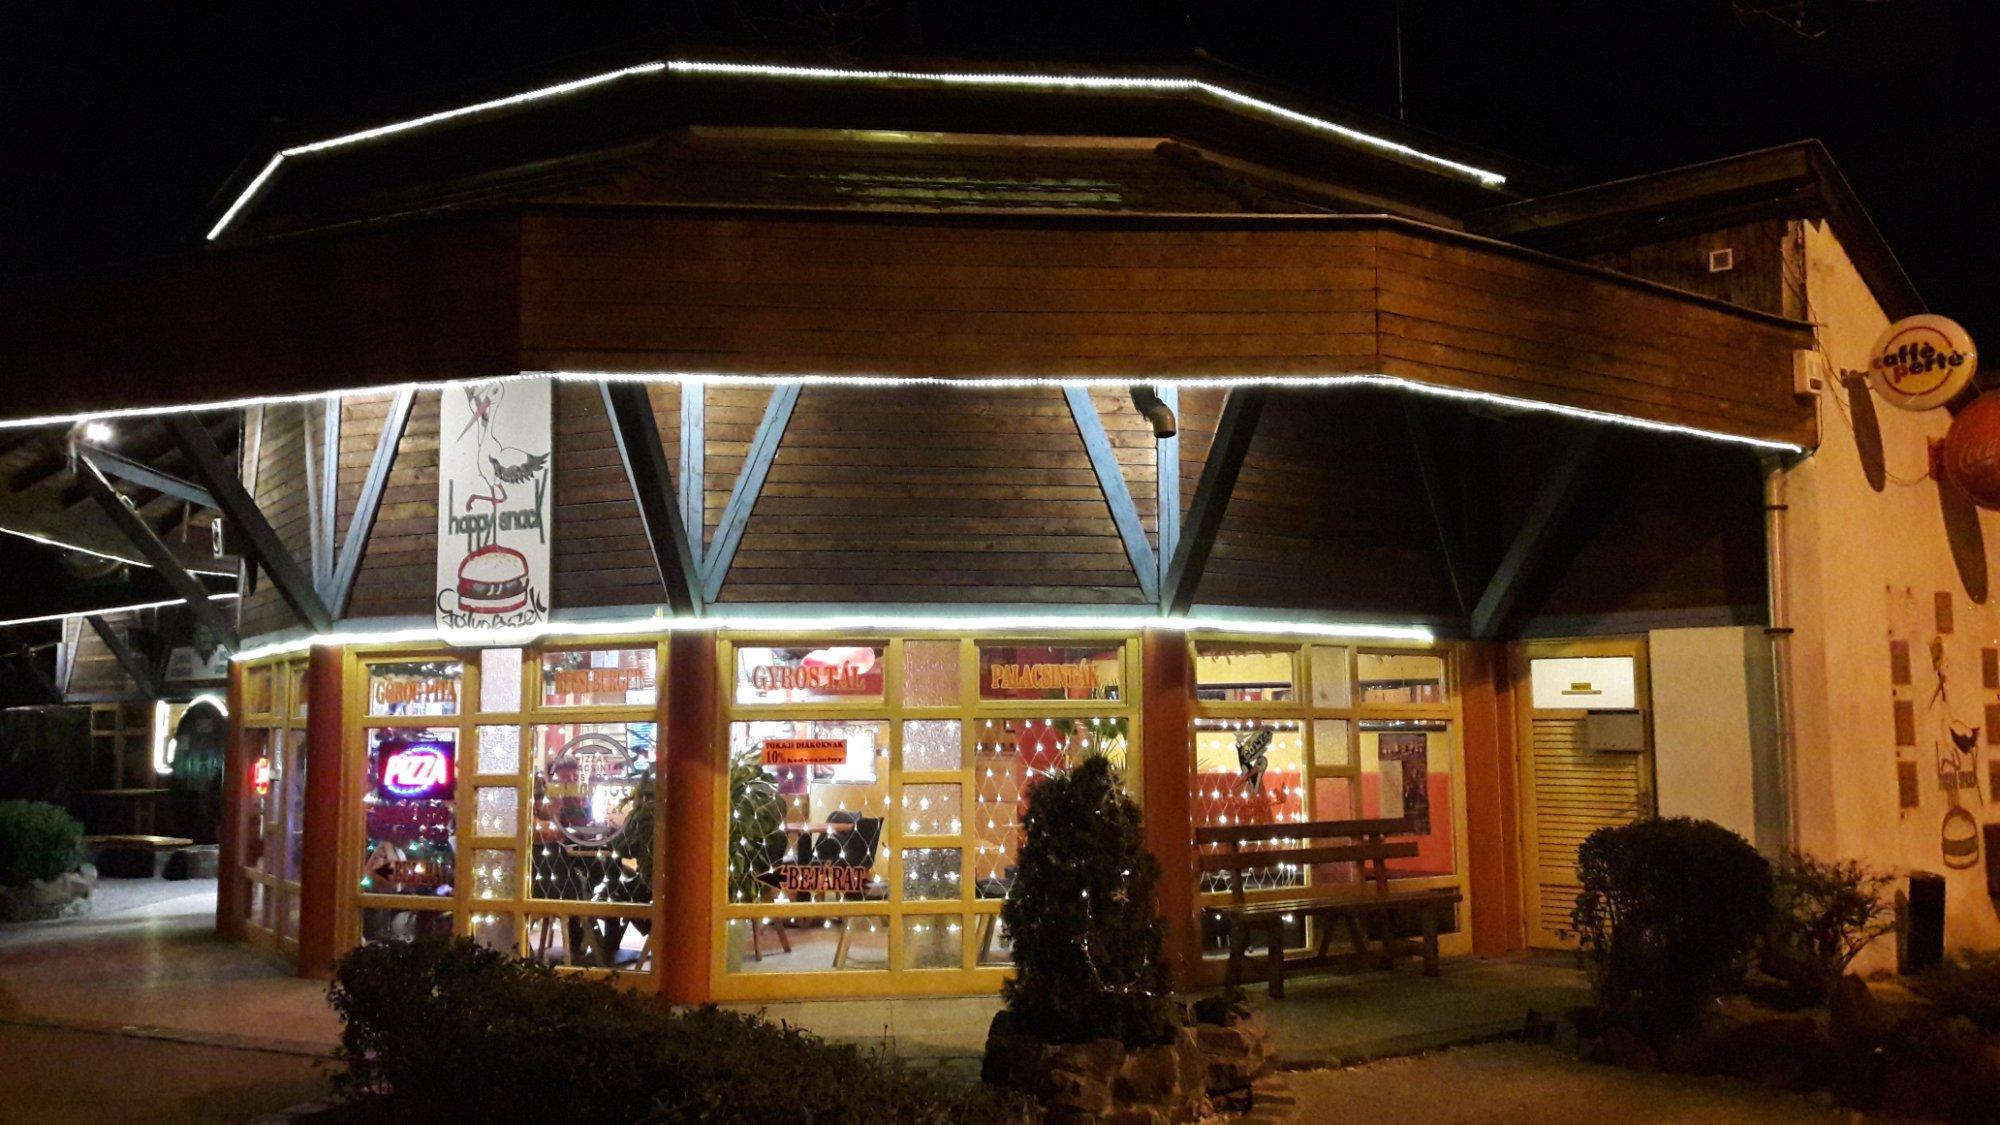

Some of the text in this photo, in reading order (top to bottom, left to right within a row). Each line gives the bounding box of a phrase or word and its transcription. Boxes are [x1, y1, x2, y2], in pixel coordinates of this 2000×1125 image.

[448, 468, 549, 552] happy snack
[752, 659, 866, 690] GYROS TÁL
[990, 658, 1099, 689] PALACSINTÁK
[766, 750, 785, 764] 10%
[796, 741, 843, 749] DIÁKOKNAK
[384, 753, 446, 785] PIZZA
[788, 859, 866, 890] BEJÁRAT
